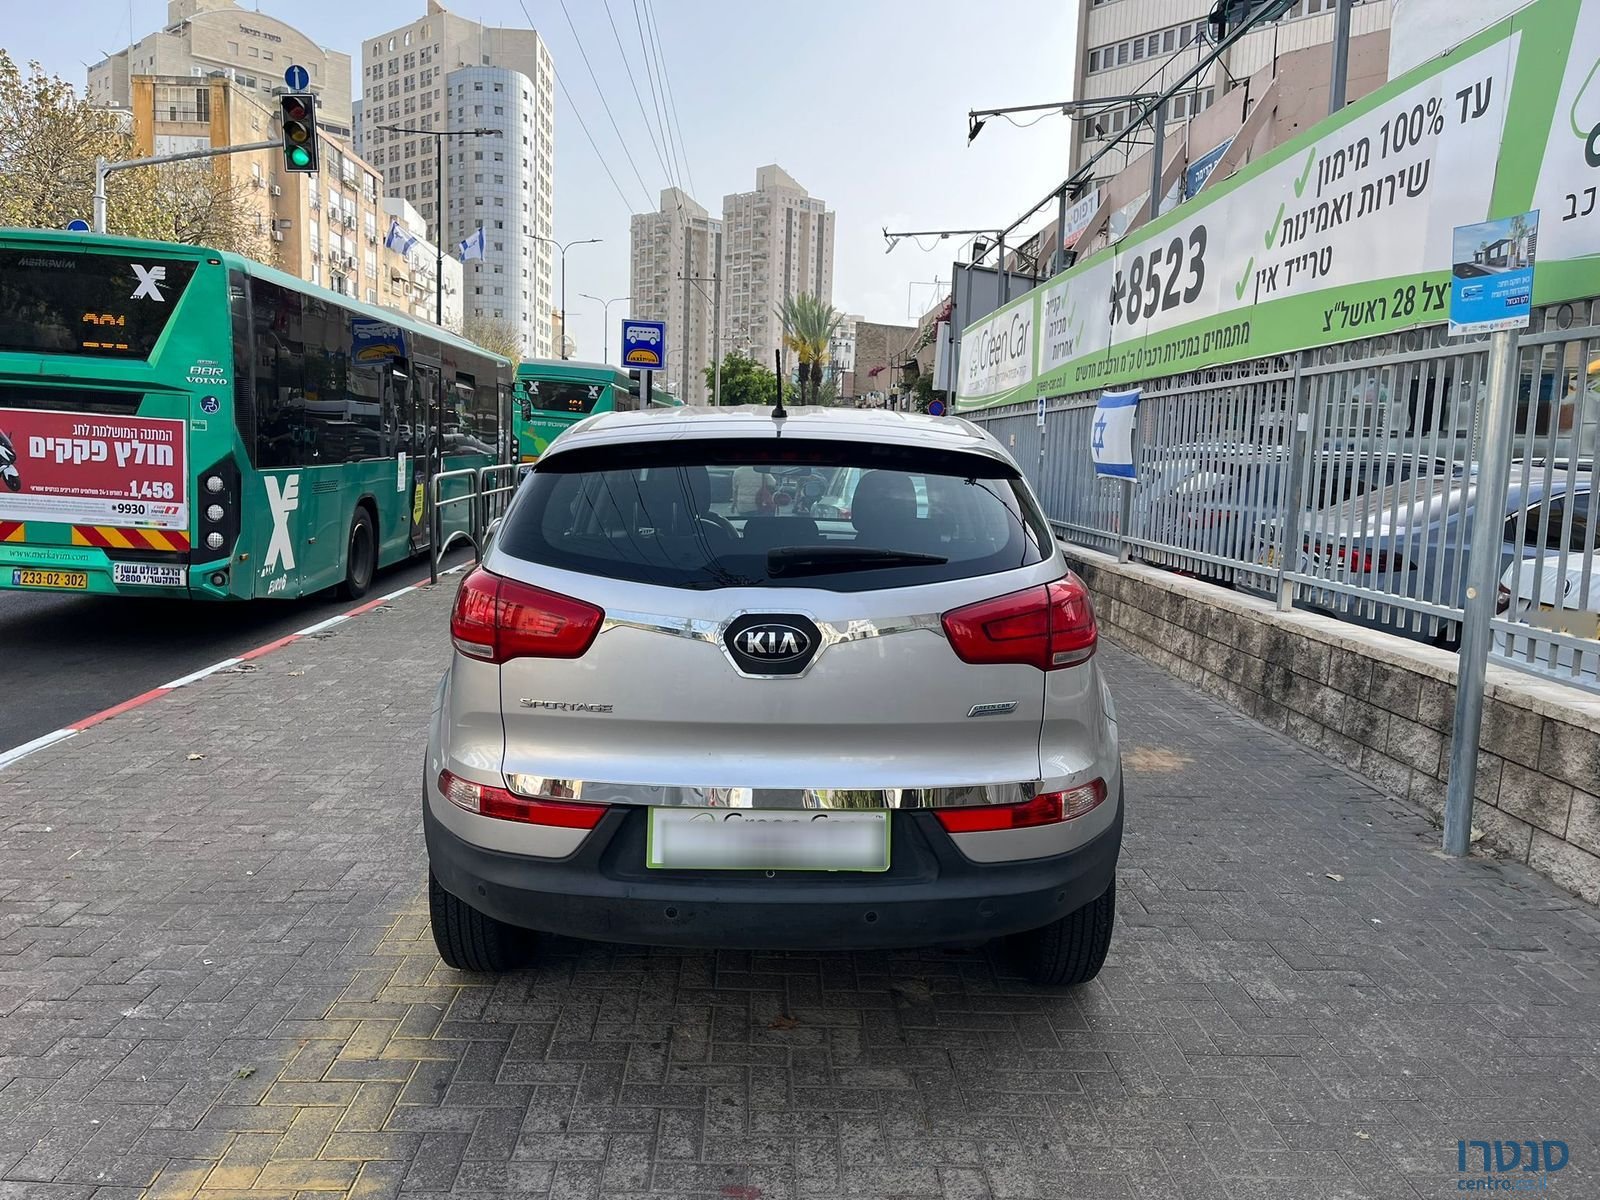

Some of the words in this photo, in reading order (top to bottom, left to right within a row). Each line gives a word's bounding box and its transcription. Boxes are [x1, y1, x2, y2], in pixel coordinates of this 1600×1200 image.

[1455, 76, 1493, 125] עד
[1380, 97, 1445, 159] 100%
[1316, 136, 1370, 198] מימון
[1357, 158, 1431, 218] שירות
[1280, 190, 1354, 248] ואמינות
[1285, 245, 1333, 287] טרייד
[1254, 262, 1278, 306] אין
[1323, 297, 1387, 332] ראשל"צ
[1391, 285, 1416, 318] 28
[979, 329, 1008, 371] Green
[1009, 313, 1031, 360] Car
[1049, 317, 1067, 338] מכירה
[1202, 321, 1250, 353] מתמחים
[1163, 335, 1200, 364] במכירת
[185, 376, 228, 386] VOLVO
[1075, 362, 1096, 382] חדשים
[1097, 356, 1120, 377] ורכבים
[72, 423, 90, 436] לחג
[92, 424, 138, 439] המושלמת
[140, 428, 173, 442] המתנה
[29, 436, 108, 465] פקקים
[114, 439, 174, 468] חולץ
[129, 480, 174, 499] 1,458
[139, 564, 159, 576] פולט
[160, 567, 181, 577] הרכב
[745, 630, 802, 655] KIA
[519, 697, 614, 714] SPORTAGE
